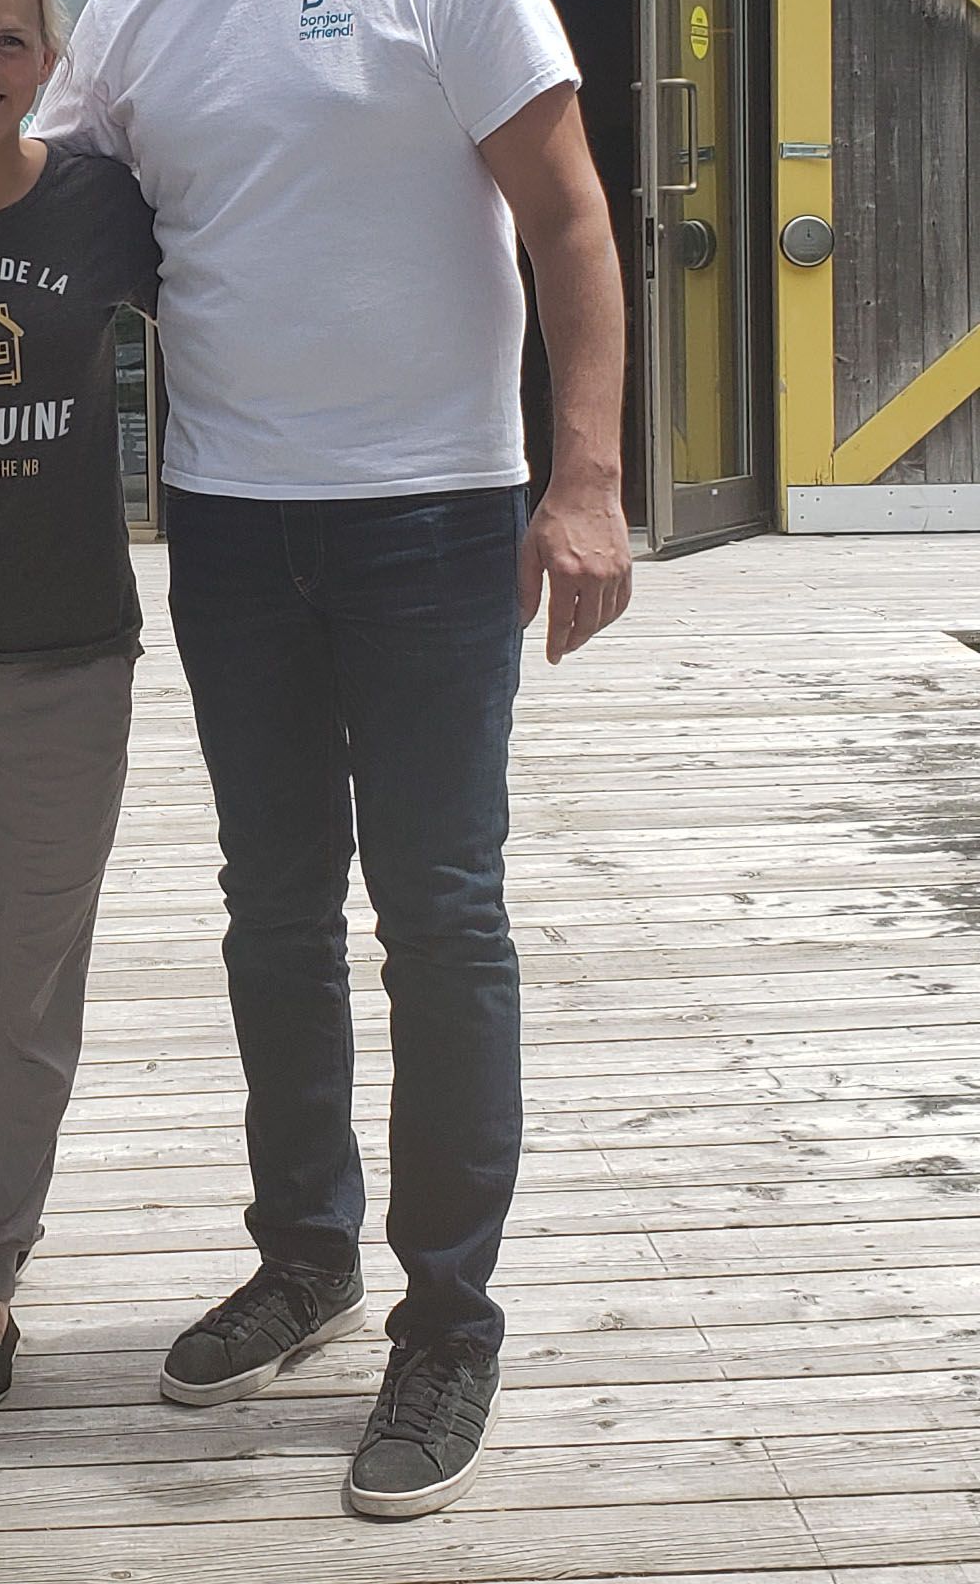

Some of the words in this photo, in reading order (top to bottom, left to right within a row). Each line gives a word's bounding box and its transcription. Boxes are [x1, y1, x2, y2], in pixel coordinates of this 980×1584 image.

[300, 10, 354, 28] bonjour
[0, 257, 31, 284] DE
[37, 267, 69, 295] LA
[22, 458, 40, 477] NB
